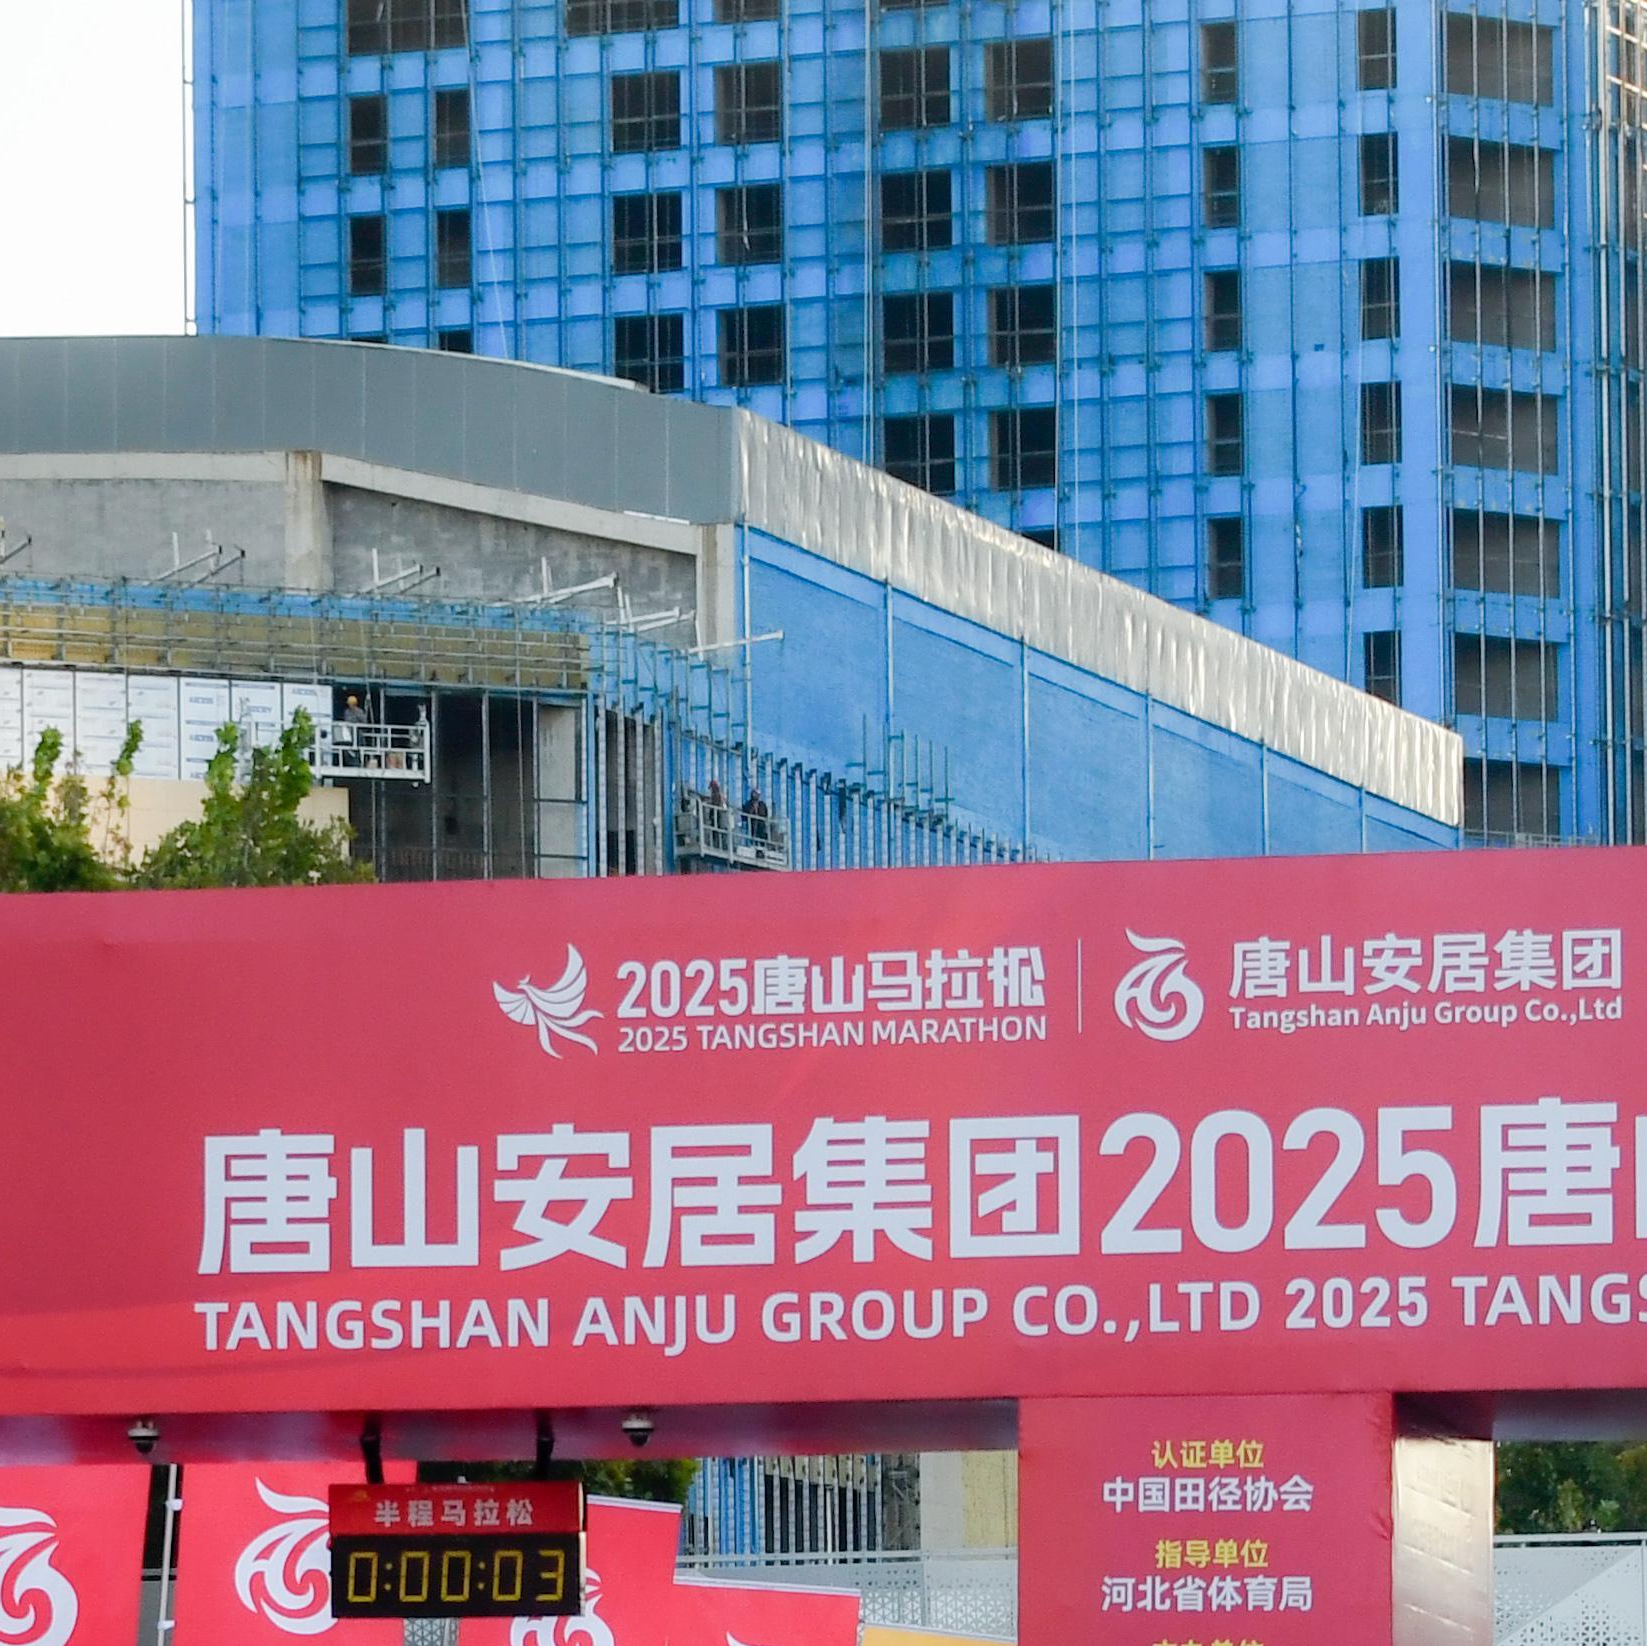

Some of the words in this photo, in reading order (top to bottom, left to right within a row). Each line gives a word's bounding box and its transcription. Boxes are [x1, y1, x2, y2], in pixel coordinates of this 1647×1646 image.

[616, 946, 1046, 1019] 2025唐山马拉松
[1227, 928, 1624, 999] 唐山安居集团
[1227, 1005, 1358, 1032] Tangshan
[1365, 1003, 1427, 1030] Anju
[1434, 1001, 1517, 1028] Group
[1523, 996, 1623, 1025] Co.,Ltd
[617, 1028, 688, 1053] 2025
[696, 1022, 865, 1051] TANGSHAN
[871, 1015, 1047, 1044] MARATHON
[194, 1298, 549, 1352] TANGSHAN
[573, 1292, 736, 1357] ANJU
[761, 1288, 988, 1344] GROUP
[1011, 1282, 1261, 1343] CO.,LTD
[1285, 1277, 1428, 1330] 2025
[1151, 1439, 1264, 1469] 认证单位
[1102, 1475, 1313, 1513] 中国田径协会
[374, 1499, 534, 1528] 半程马拉松
[1155, 1540, 1268, 1569] 指导单位
[347, 1549, 565, 1602] 0:00:03
[1101, 1575, 1313, 1613] 河北省体育局
